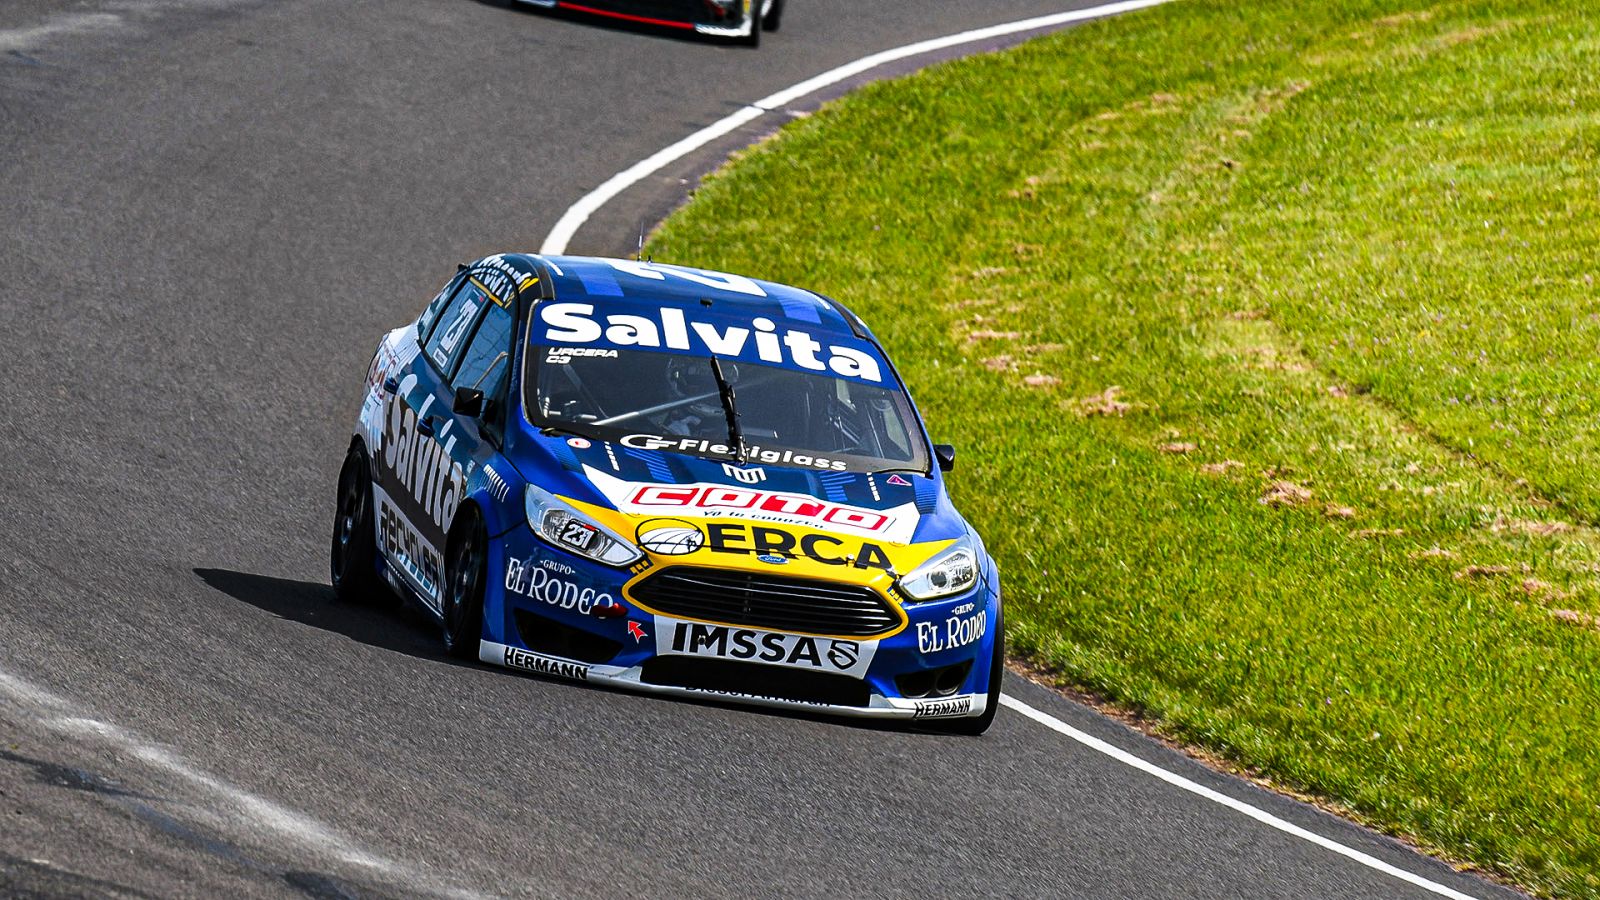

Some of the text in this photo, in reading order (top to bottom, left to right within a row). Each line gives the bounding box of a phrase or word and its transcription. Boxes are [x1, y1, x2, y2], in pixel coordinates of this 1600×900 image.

[541, 303, 882, 382] Salvita
[631, 486, 889, 530] COTO
[561, 523, 595, 549] 231
[706, 523, 893, 572] ERCA
[505, 557, 525, 594] EL
[672, 622, 823, 667] IMSSA
[916, 622, 943, 653] EL
[504, 647, 588, 679] HERMANN
[914, 699, 971, 718] HERMANN
